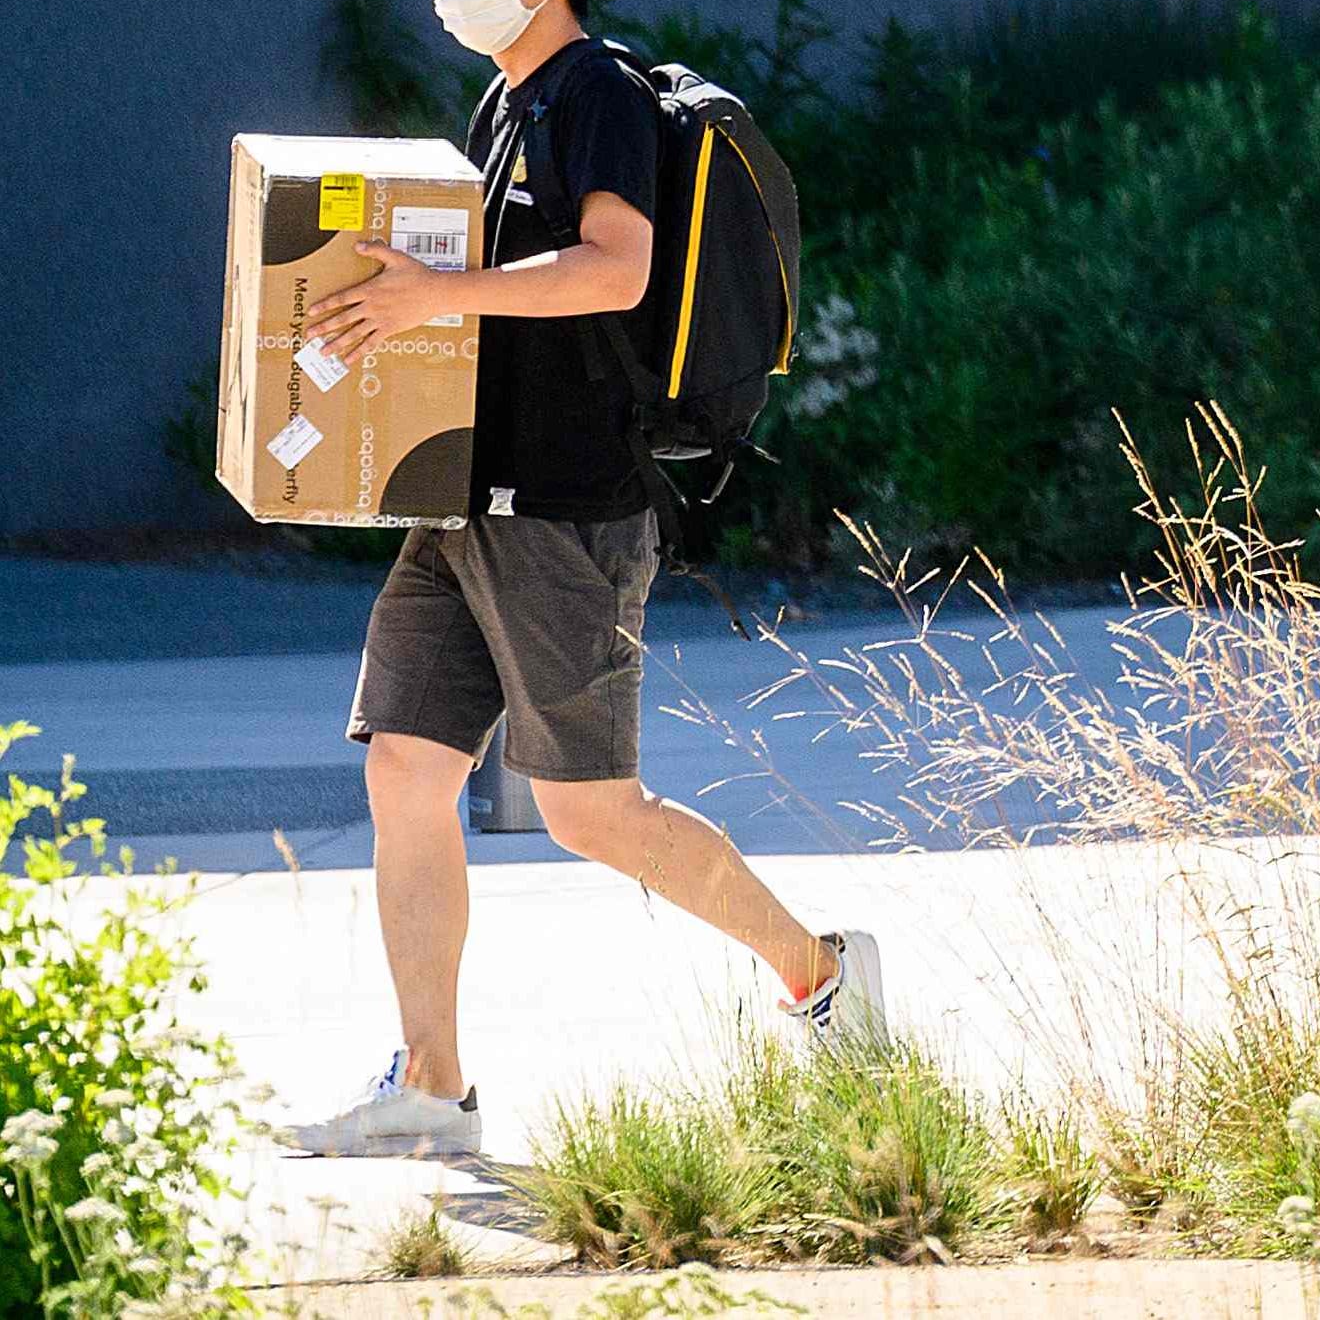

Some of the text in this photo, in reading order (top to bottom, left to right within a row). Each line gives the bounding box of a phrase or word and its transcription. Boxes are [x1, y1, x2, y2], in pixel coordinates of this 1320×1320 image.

[293, 277, 308, 318] Meet
[378, 336, 456, 357] bugabo
[287, 361, 304, 421] Bugabo
